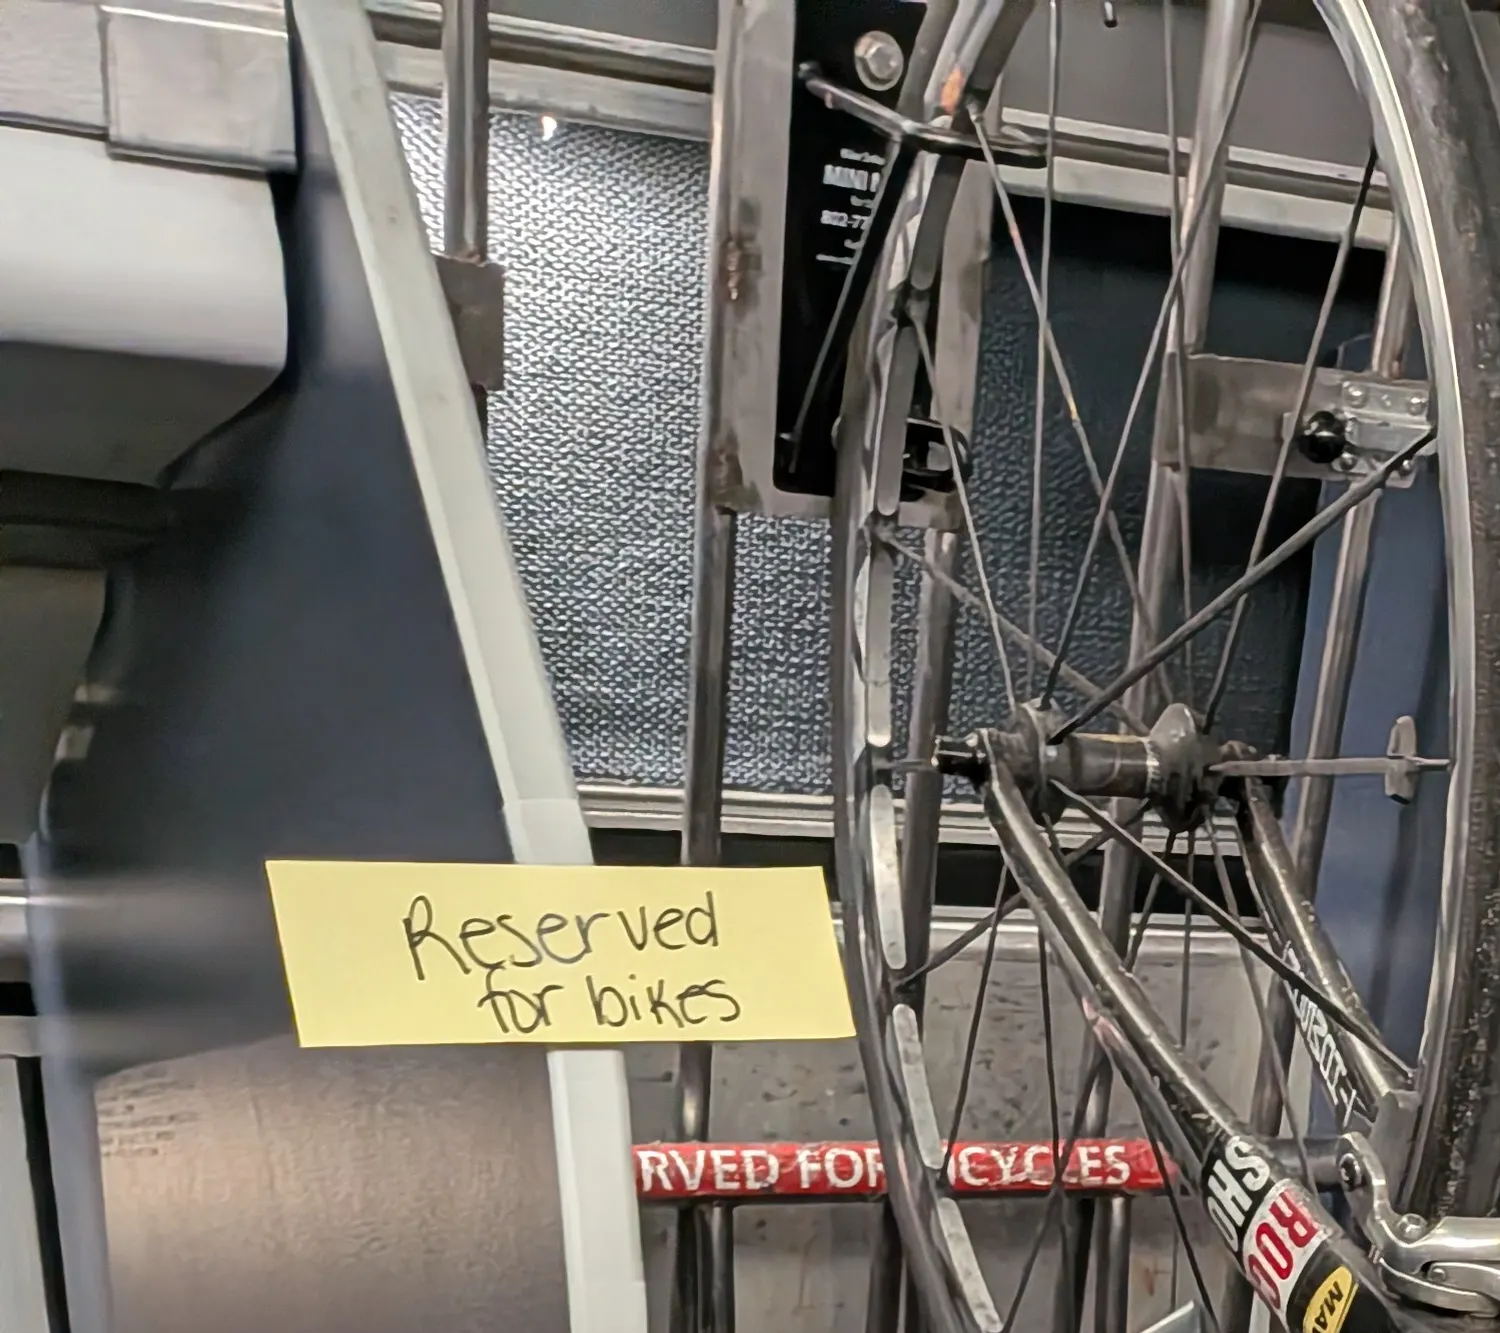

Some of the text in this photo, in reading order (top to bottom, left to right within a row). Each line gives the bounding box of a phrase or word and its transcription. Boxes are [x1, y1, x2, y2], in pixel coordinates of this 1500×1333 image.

[402, 891, 719, 981] Reserved
[477, 964, 742, 1035] for bikes
